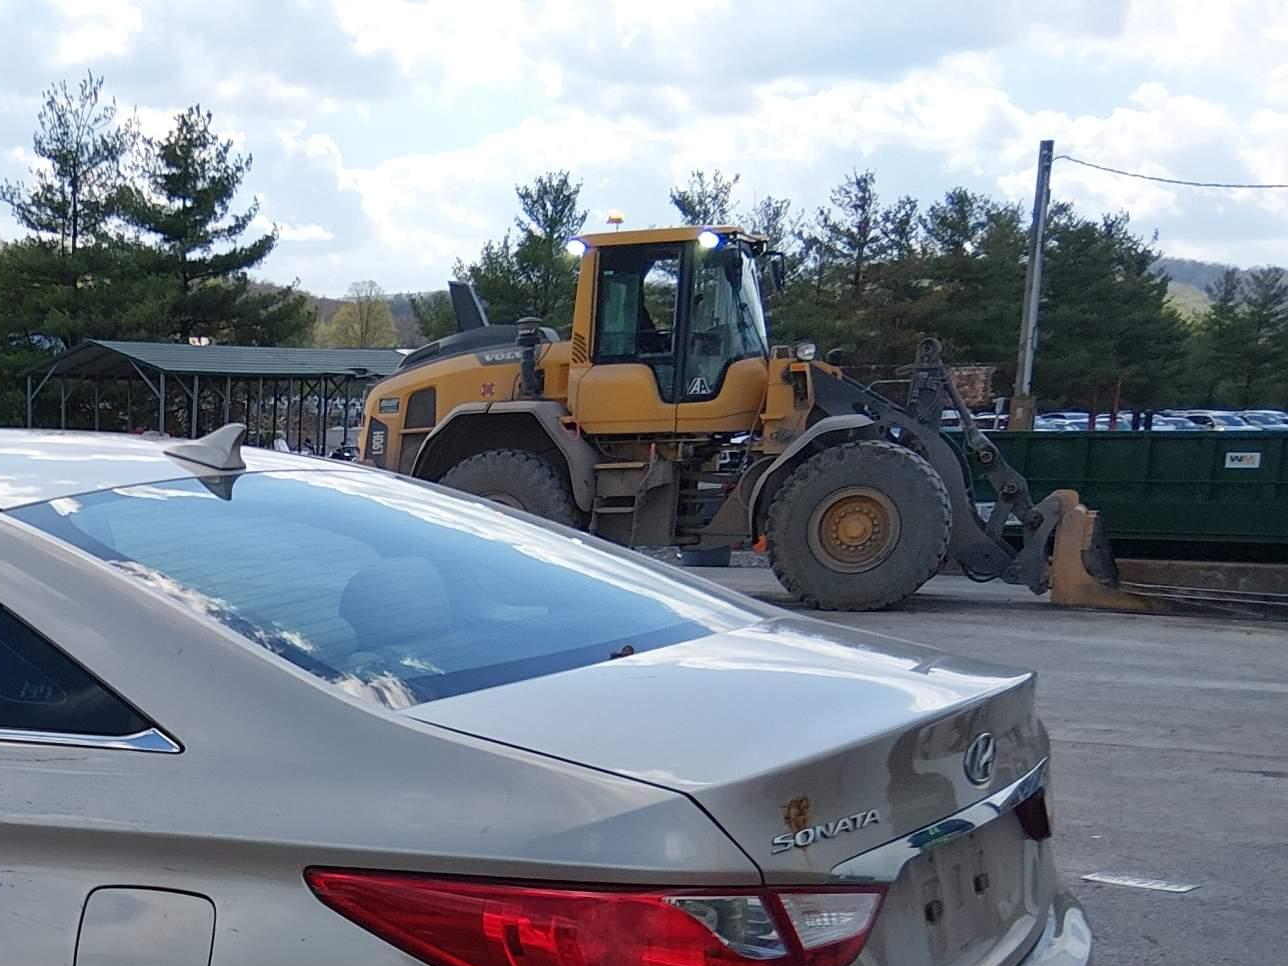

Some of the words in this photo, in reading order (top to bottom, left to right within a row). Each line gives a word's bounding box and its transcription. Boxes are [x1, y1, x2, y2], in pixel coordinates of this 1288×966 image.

[484, 352, 522, 362] VOLV
[372, 431, 384, 455] L90H
[772, 808, 881, 855] SONATA
